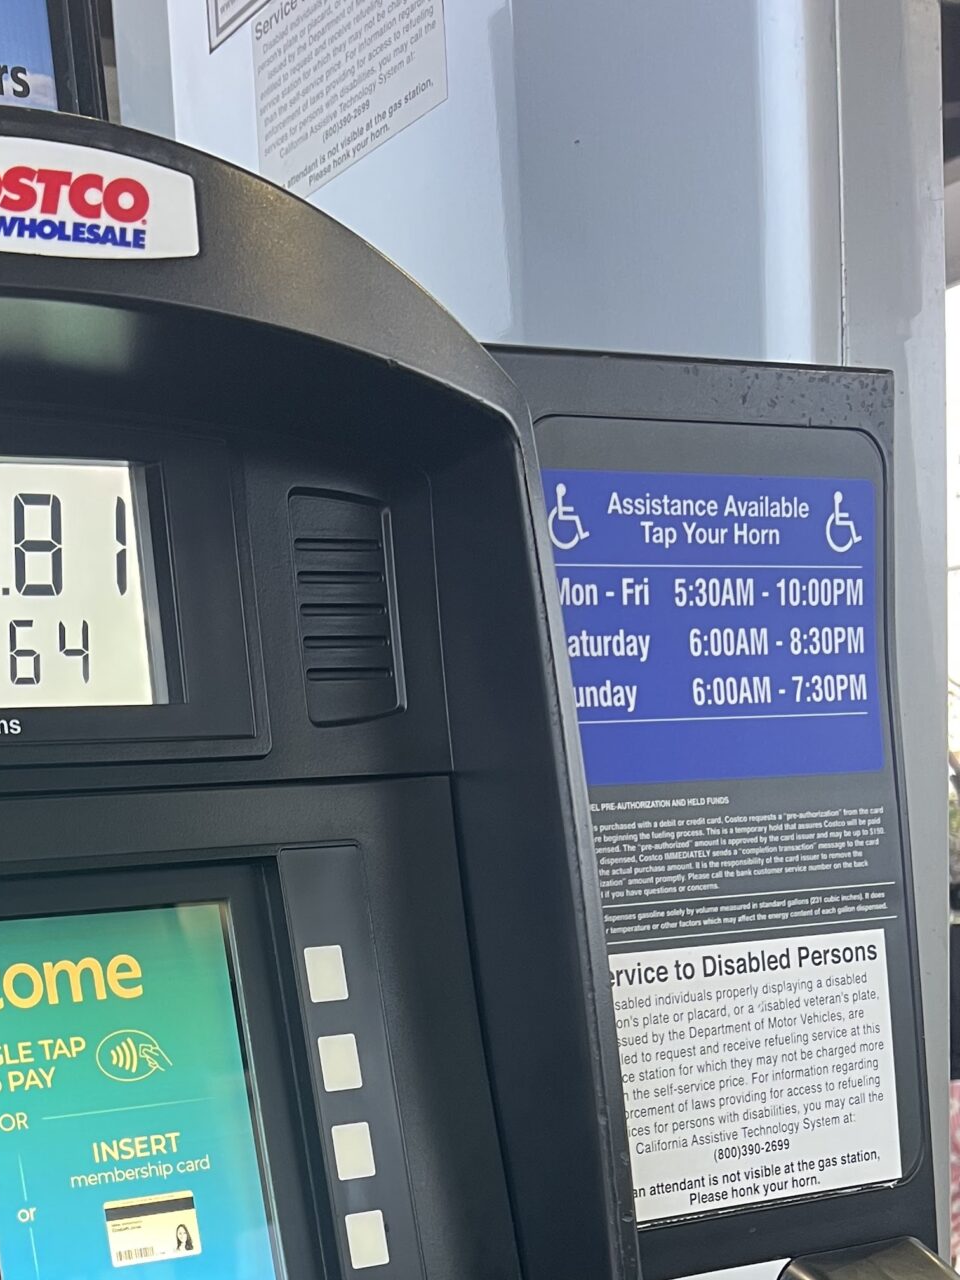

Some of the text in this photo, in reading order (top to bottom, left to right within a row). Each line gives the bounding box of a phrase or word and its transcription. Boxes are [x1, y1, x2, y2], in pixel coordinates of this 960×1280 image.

[388, 80, 434, 117] gas station,
[608, 492, 809, 518] Assistance Available
[640, 521, 780, 548] Tap Your Horn
[622, 578, 650, 605] Fri
[674, 578, 754, 606] 5:30AM
[777, 579, 863, 606] 10:00PM
[568, 627, 864, 661] aturday 6:00AM 8:30PM
[573, 674, 867, 712] unday 6:00AM 7:30PM
[674, 958, 695, 981] to
[703, 946, 791, 979] Disabled
[797, 942, 877, 969] Persons
[654, 977, 813, 1005] individuals properly displaying
[37, 1037, 86, 1062] TAP
[8, 1067, 56, 1092] PAY
[92, 1132, 180, 1164] INSERT
[713, 1138, 790, 1162] (800)390-2699
[70, 1155, 210, 1189] membership card
[689, 1173, 820, 1206] Please honk your horn.
[17, 1207, 36, 1222] or
